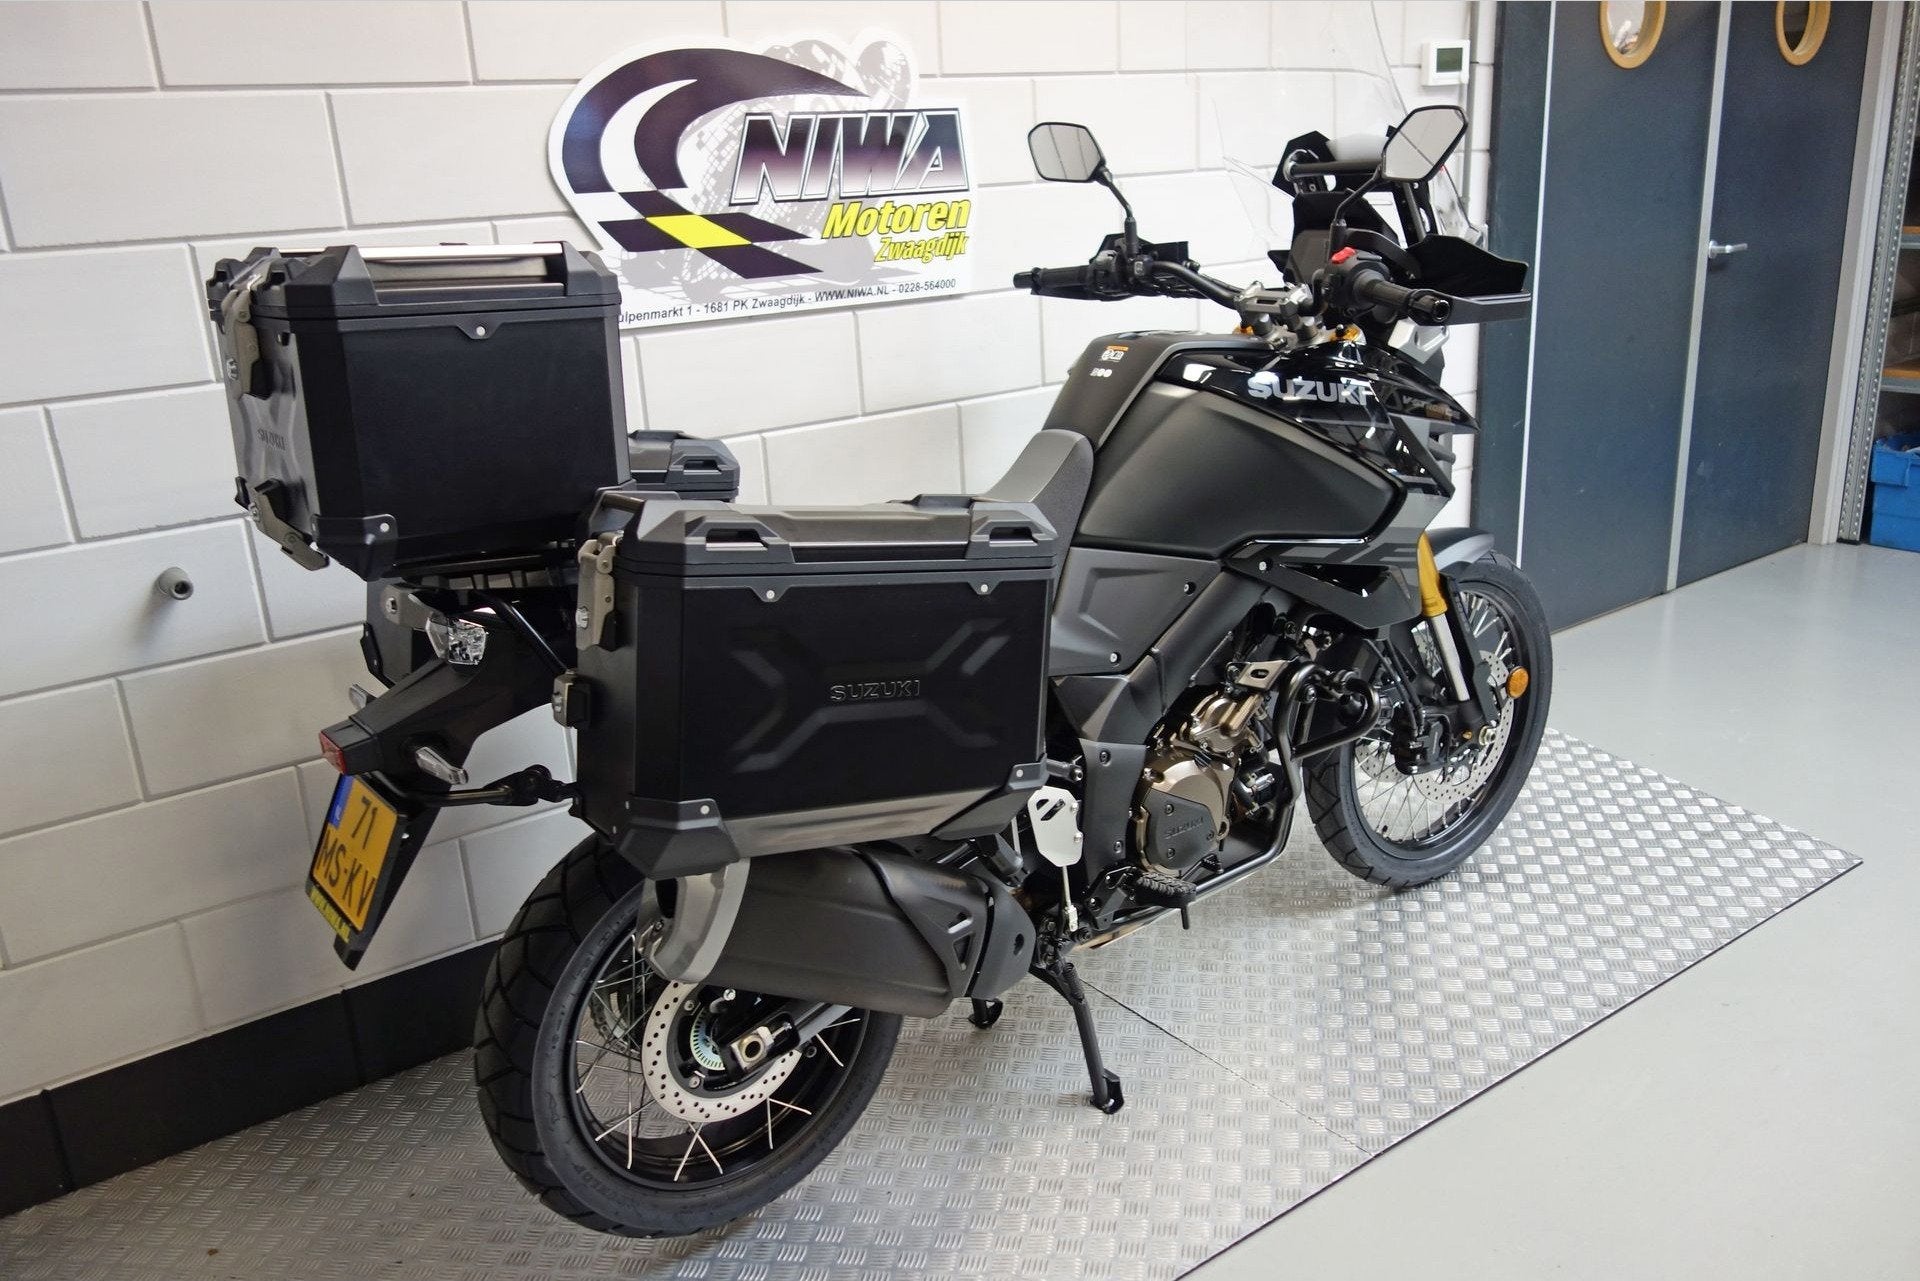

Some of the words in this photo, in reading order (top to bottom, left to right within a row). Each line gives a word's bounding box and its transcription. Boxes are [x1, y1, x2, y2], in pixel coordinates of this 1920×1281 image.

[729, 108, 969, 206] NIWA
[821, 199, 971, 239] Motoren
[874, 231, 969, 263] Zwaagdijk
[618, 306, 683, 325] ulpenmarkt
[687, 305, 693, 316] 1
[704, 301, 729, 314] 1681
[733, 299, 749, 311] PK
[752, 293, 805, 310] Zwaagdijk
[815, 286, 889, 302] WWW.NIWA.NL
[899, 279, 957, 294] 0228-564000
[1248, 375, 1376, 405] SUZUKI
[830, 680, 920, 701] SUZUKI
[351, 796, 378, 850] 71
[316, 829, 376, 918] MS-KV
